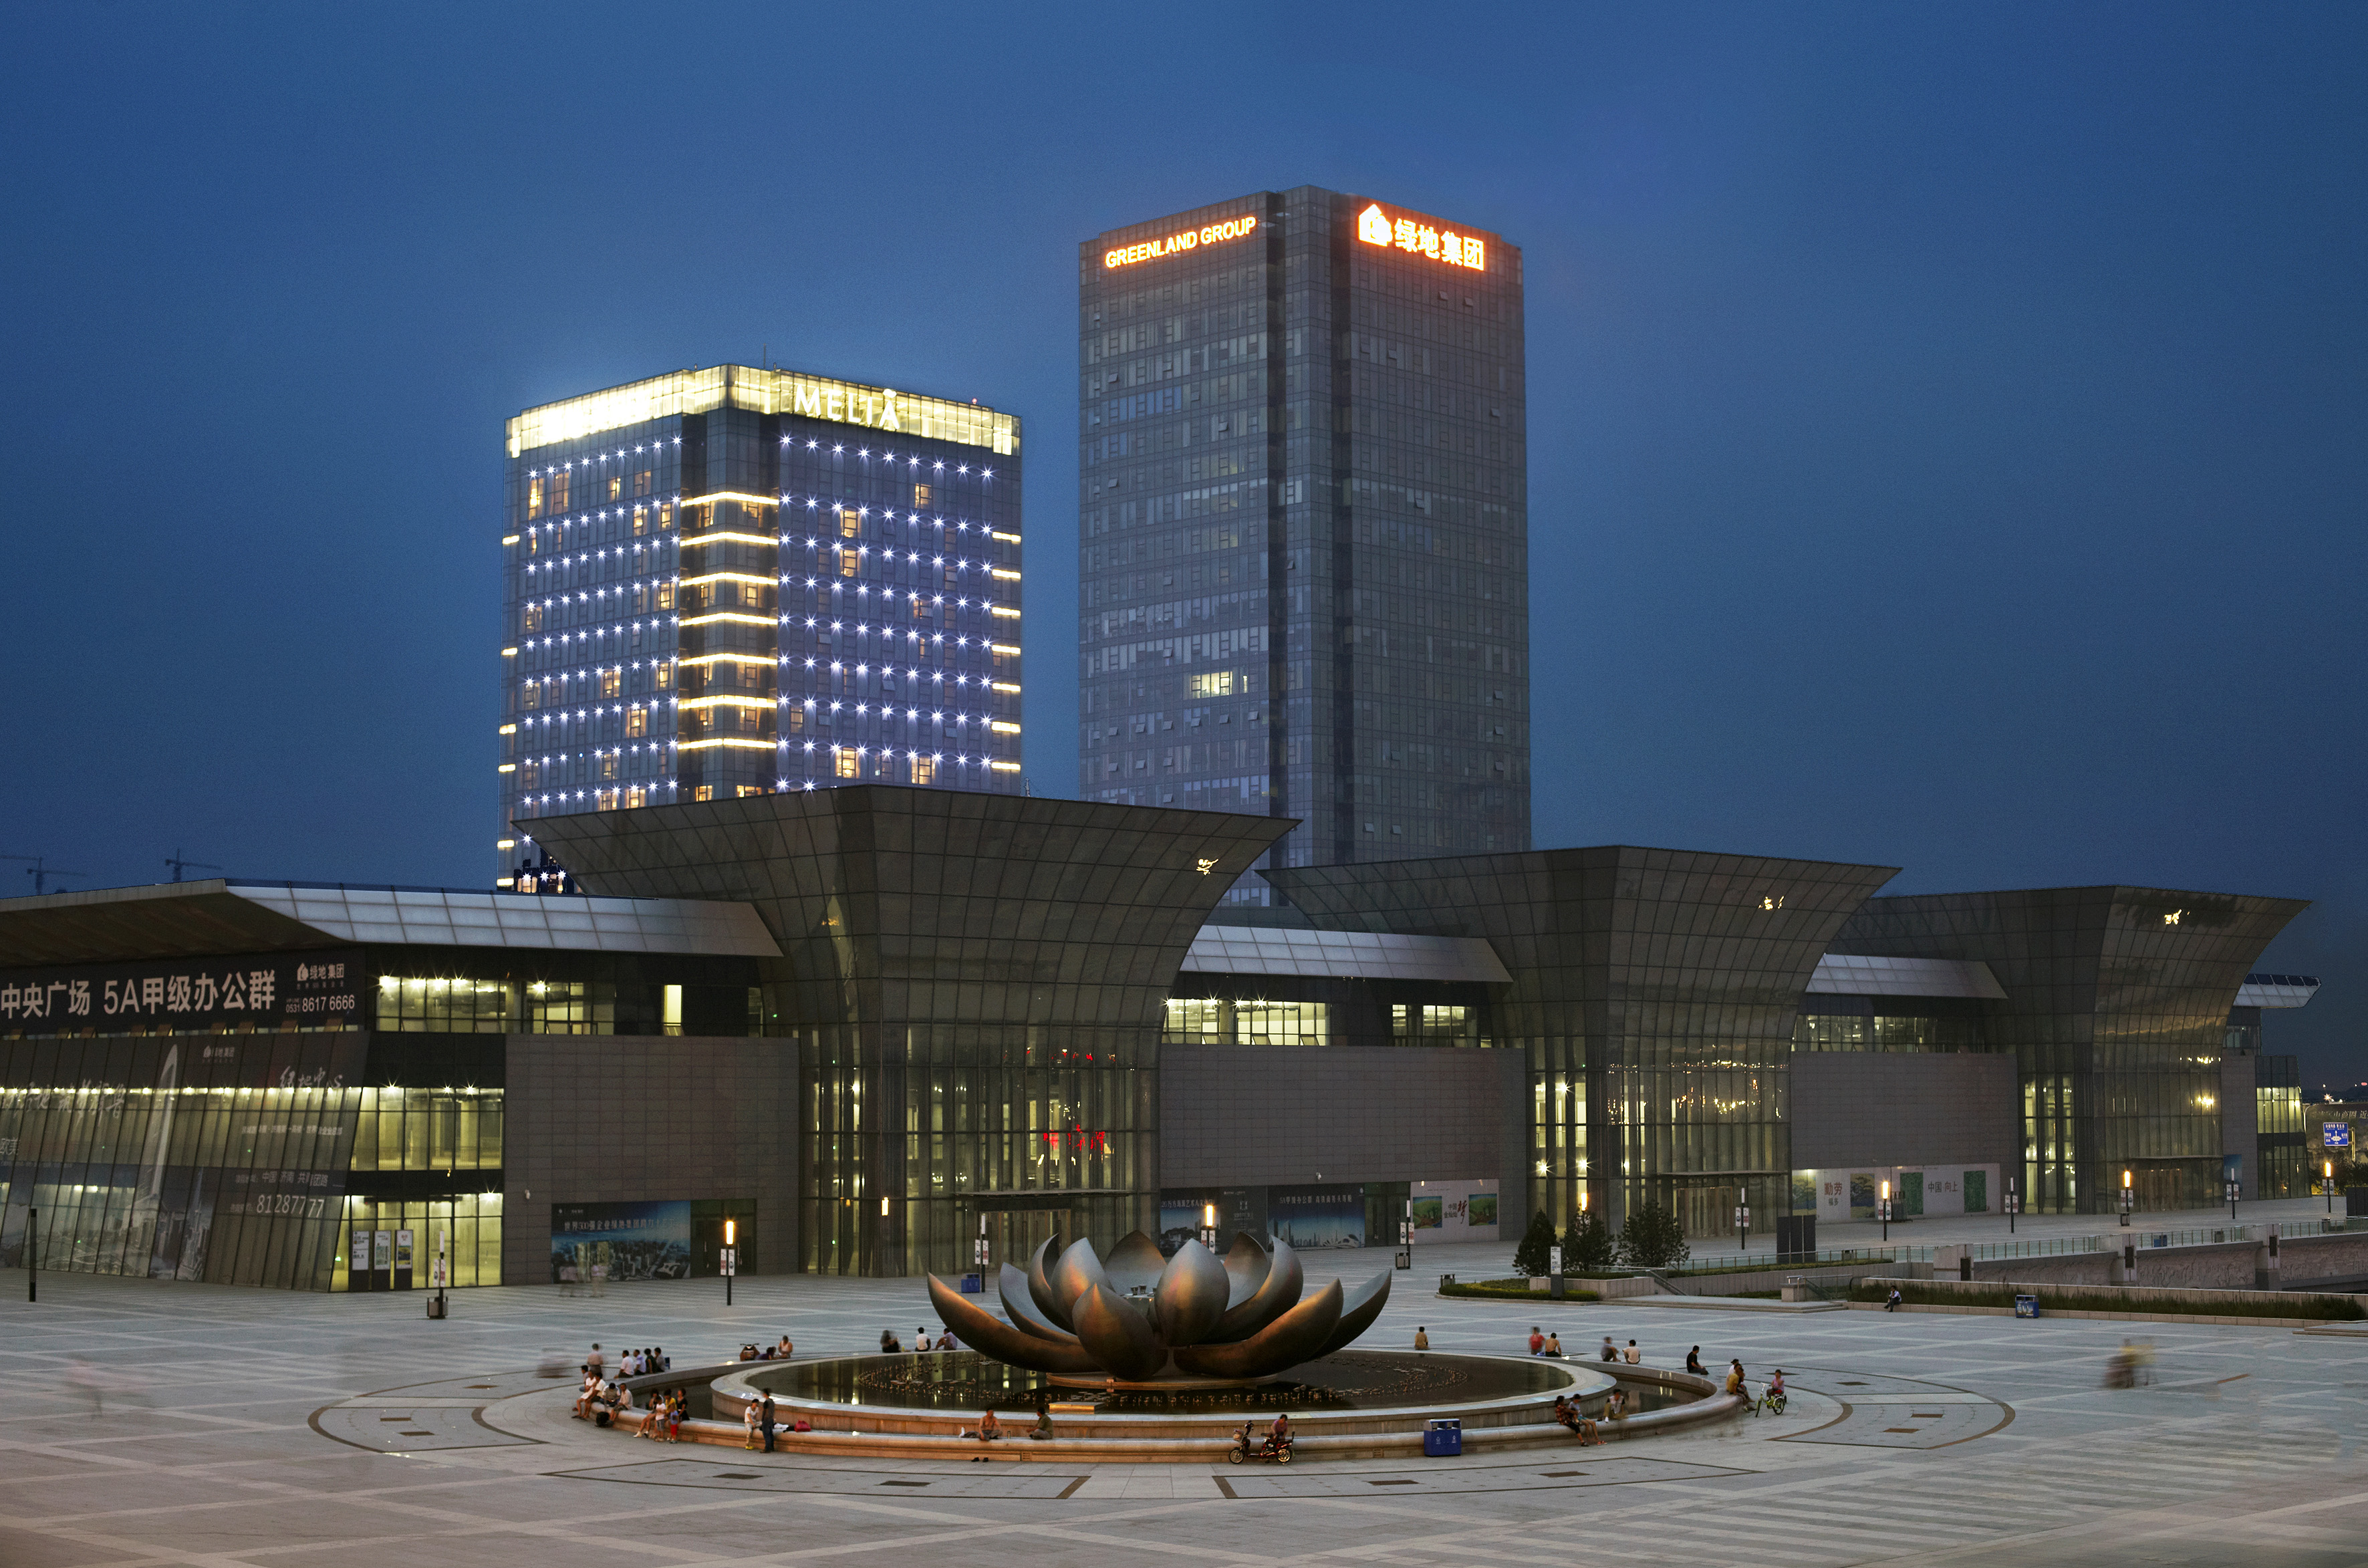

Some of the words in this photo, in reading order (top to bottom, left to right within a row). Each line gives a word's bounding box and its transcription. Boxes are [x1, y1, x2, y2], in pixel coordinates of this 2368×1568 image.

[1105, 231, 1198, 269] GREENLAND
[1200, 216, 1257, 245] GROUP
[1394, 217, 1485, 271] 绿地集团
[309, 963, 344, 980] 绿地集团
[1, 979, 90, 1019] 中央广场
[104, 969, 275, 1015] 5A甲级办公群
[285, 1004, 300, 1013] 0531
[302, 997, 326, 1012] 8617
[330, 995, 355, 1011] 6666
[257, 1194, 325, 1218] 81287777
